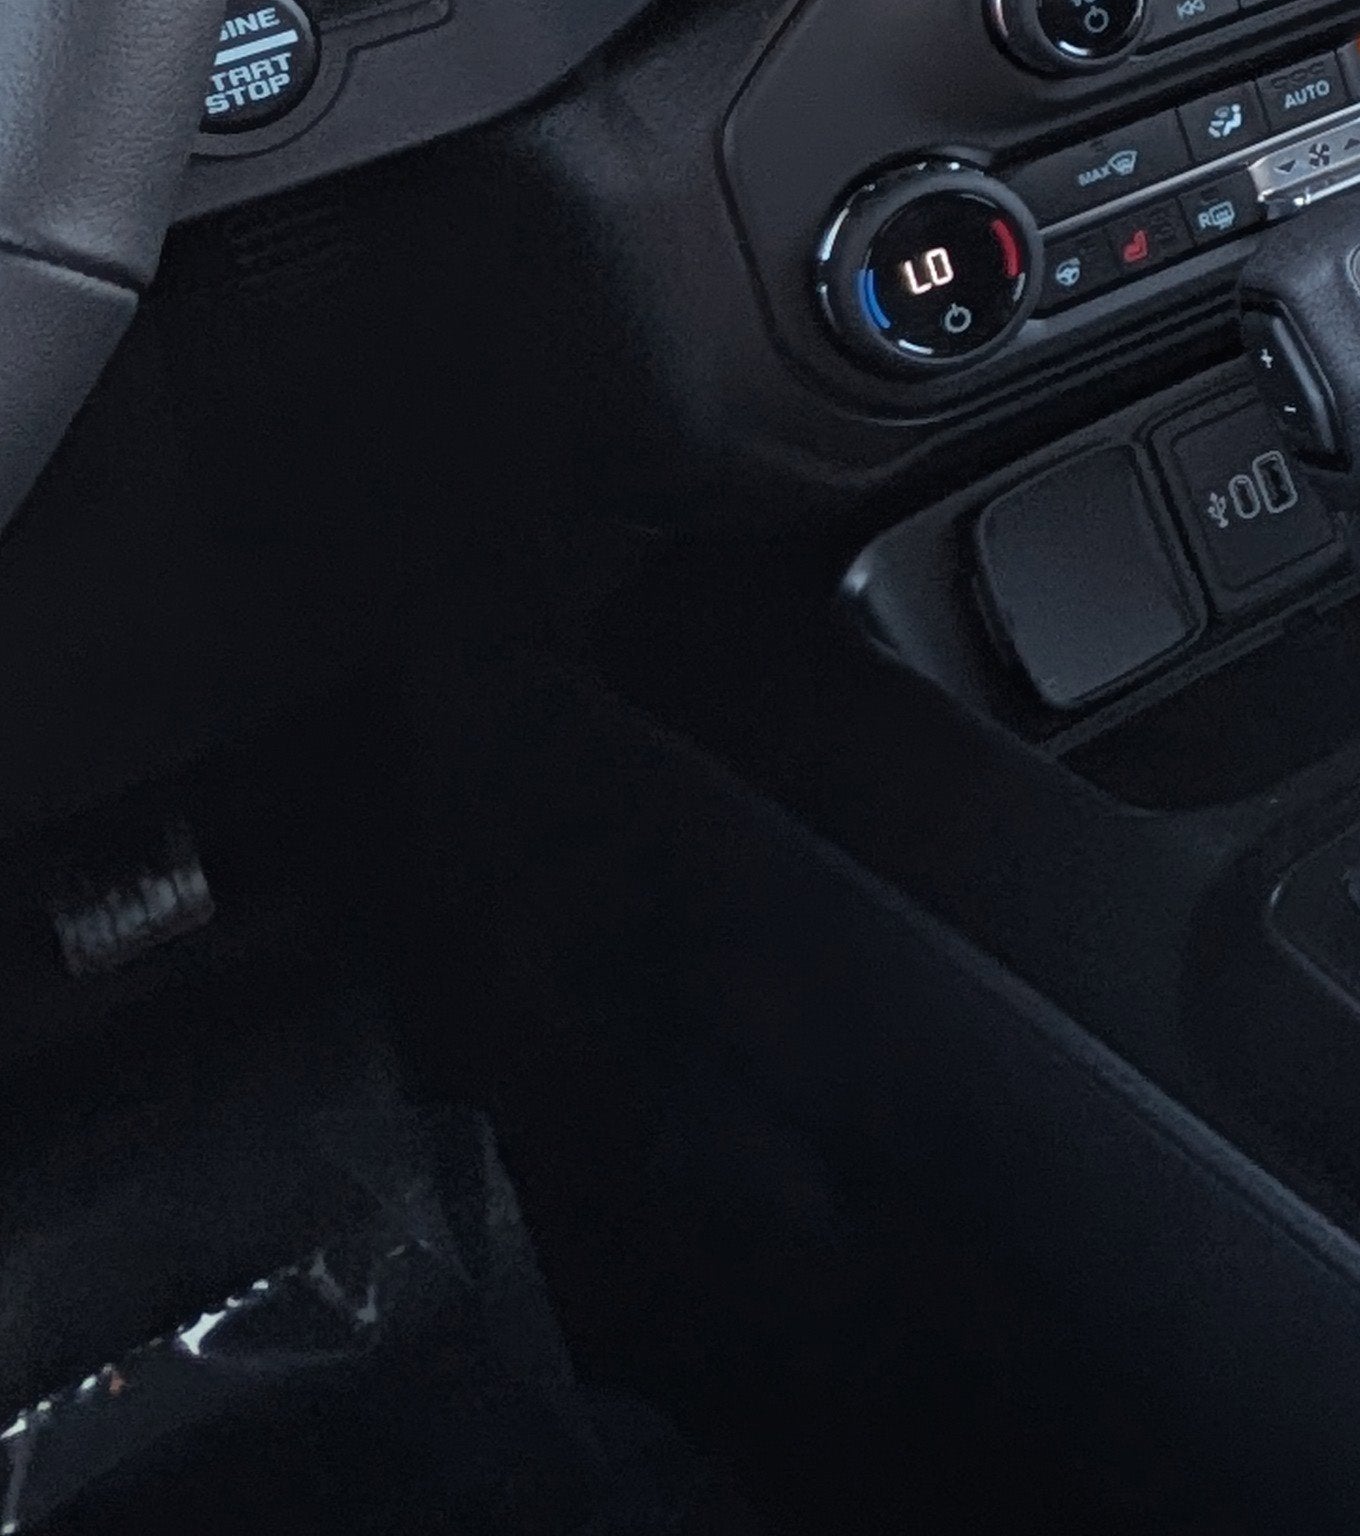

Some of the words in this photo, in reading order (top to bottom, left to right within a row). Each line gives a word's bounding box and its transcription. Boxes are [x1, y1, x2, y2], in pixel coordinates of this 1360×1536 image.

[211, 52, 292, 92] TART
[204, 73, 291, 115] STOP
[1284, 79, 1330, 109] AUTO
[1078, 166, 1111, 188] MAX
[903, 246, 954, 296] LO
